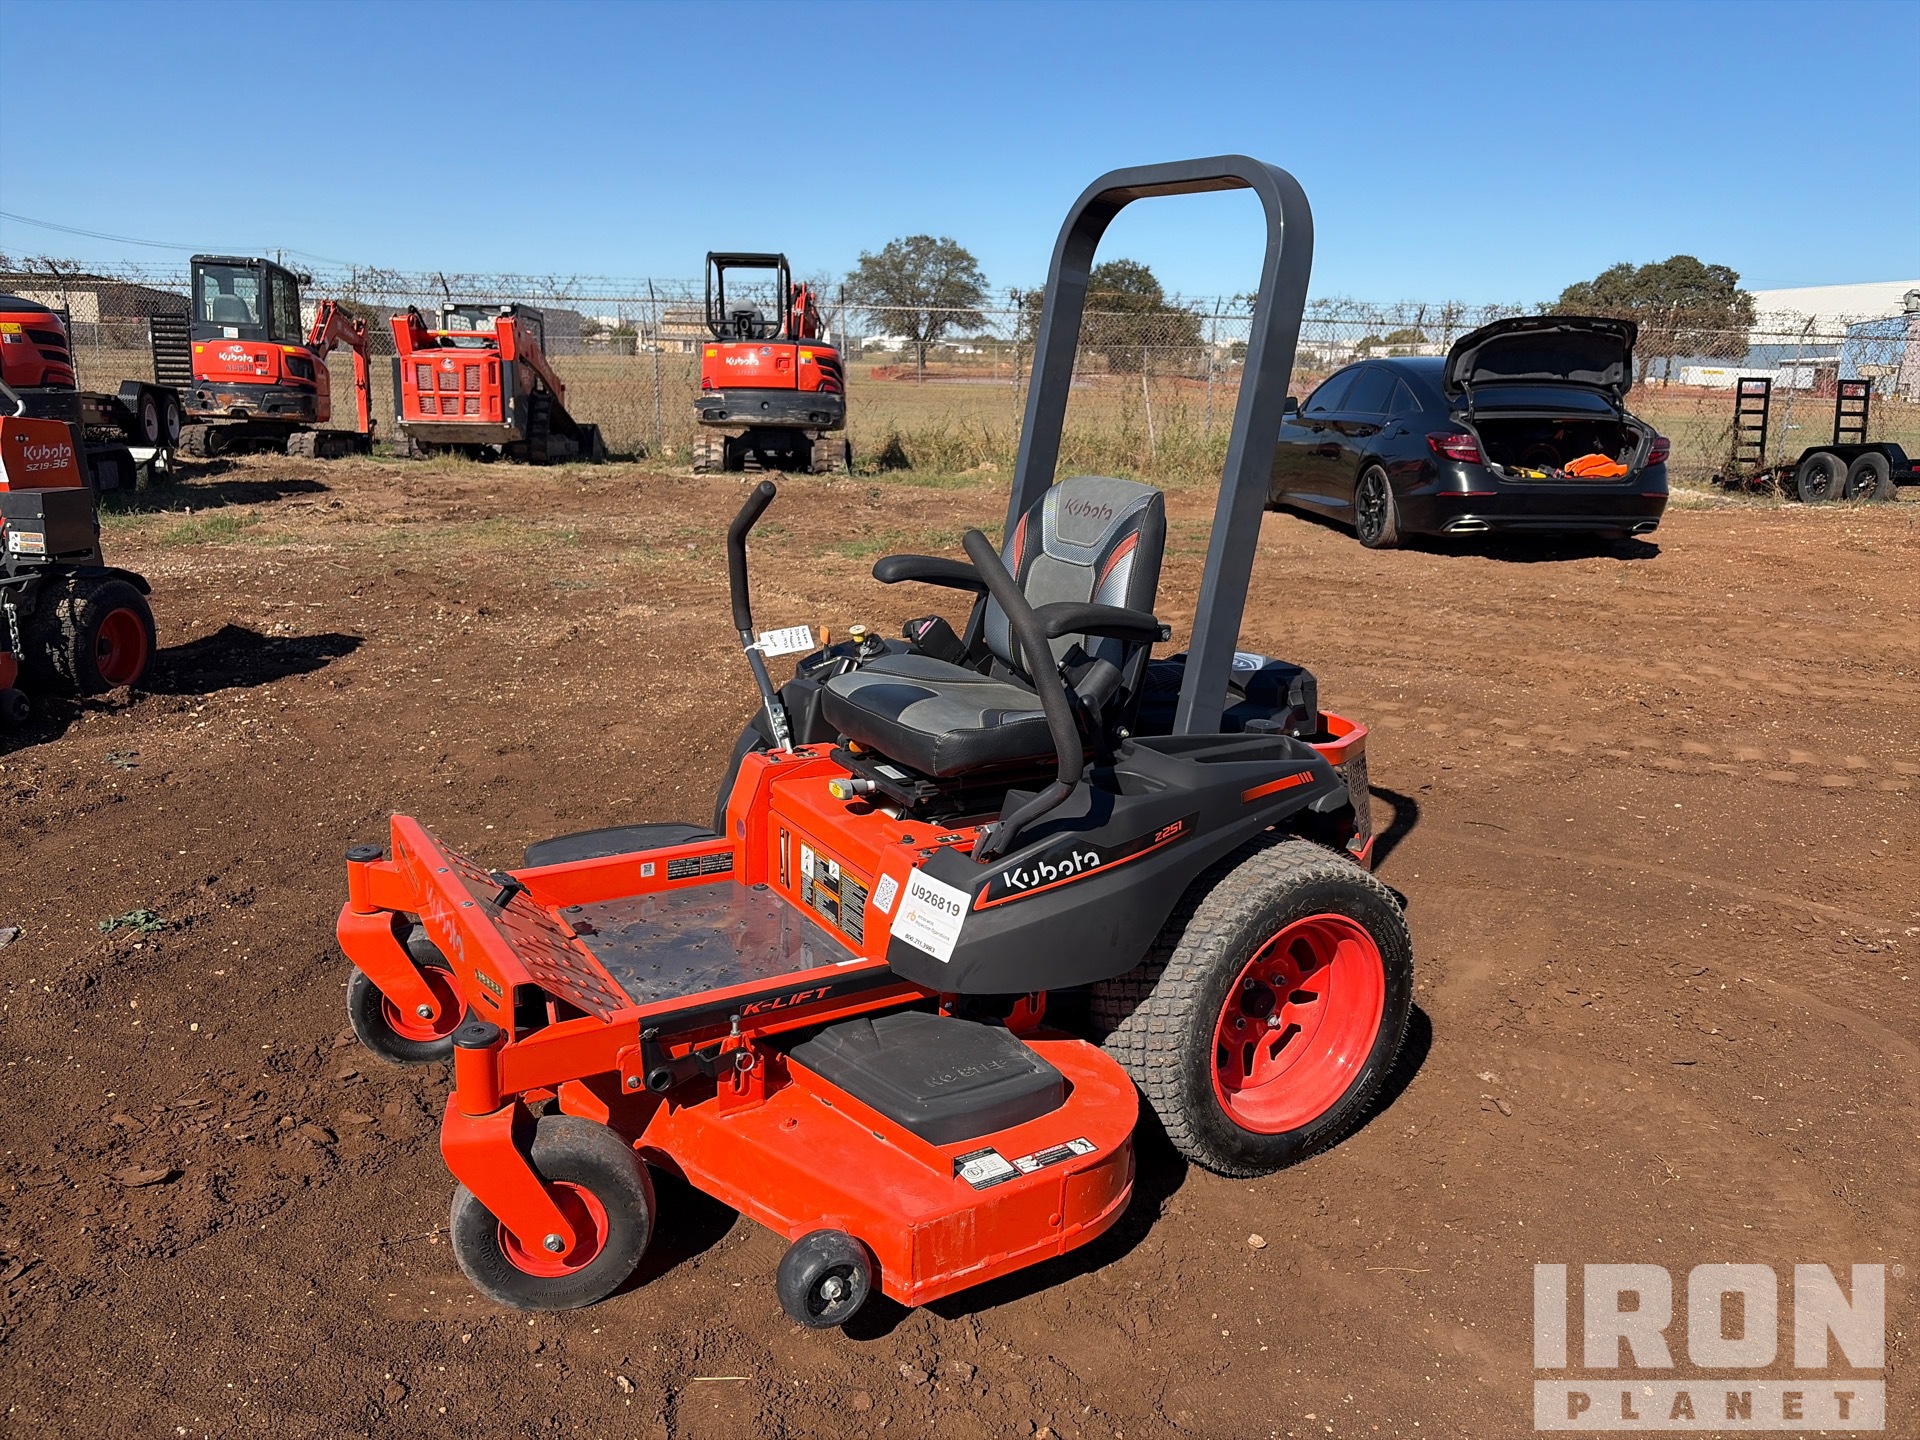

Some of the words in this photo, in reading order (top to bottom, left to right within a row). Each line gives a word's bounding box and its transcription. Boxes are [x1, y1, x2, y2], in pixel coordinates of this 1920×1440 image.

[218, 352, 254, 363] Kubota
[725, 353, 760, 366] Kubota
[23, 443, 72, 461] Kubota
[25, 458, 69, 472] SZ19-36
[1064, 498, 1113, 520] Kubota
[1003, 850, 1101, 889] Kubota
[911, 882, 961, 917] U926819
[743, 985, 832, 1016] K-LIFT
